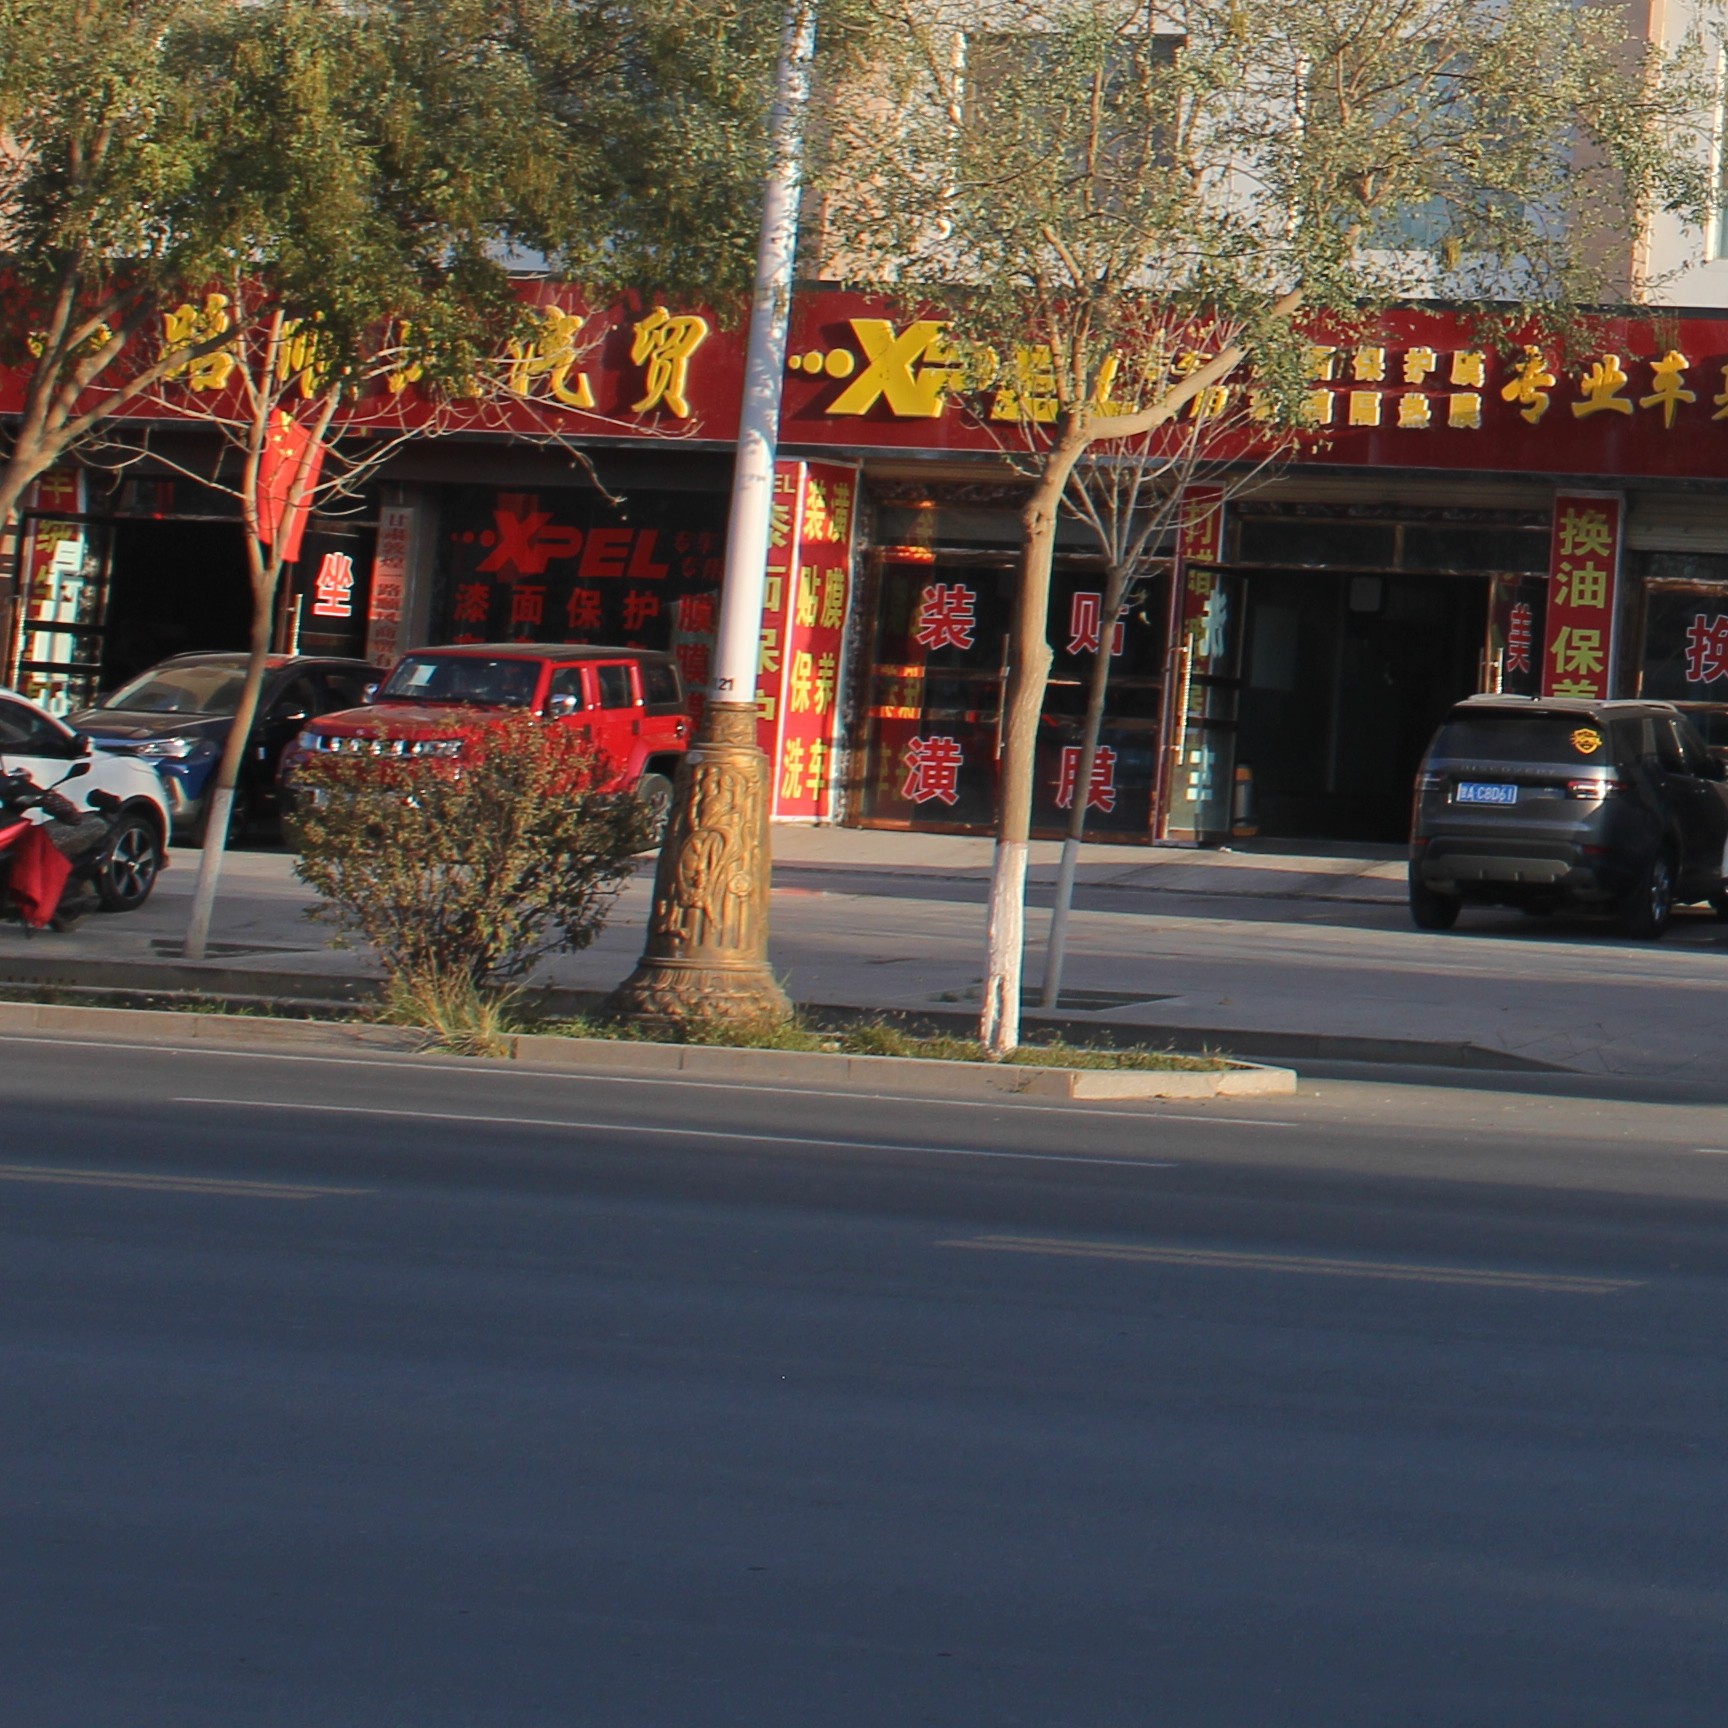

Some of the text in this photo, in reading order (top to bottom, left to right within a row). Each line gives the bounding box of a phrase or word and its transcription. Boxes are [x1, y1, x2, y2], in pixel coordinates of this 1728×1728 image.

[476, 509, 671, 579] XPEL
[313, 551, 354, 617] 坐
[790, 649, 834, 715] 保养
[781, 737, 826, 801] 洗车
